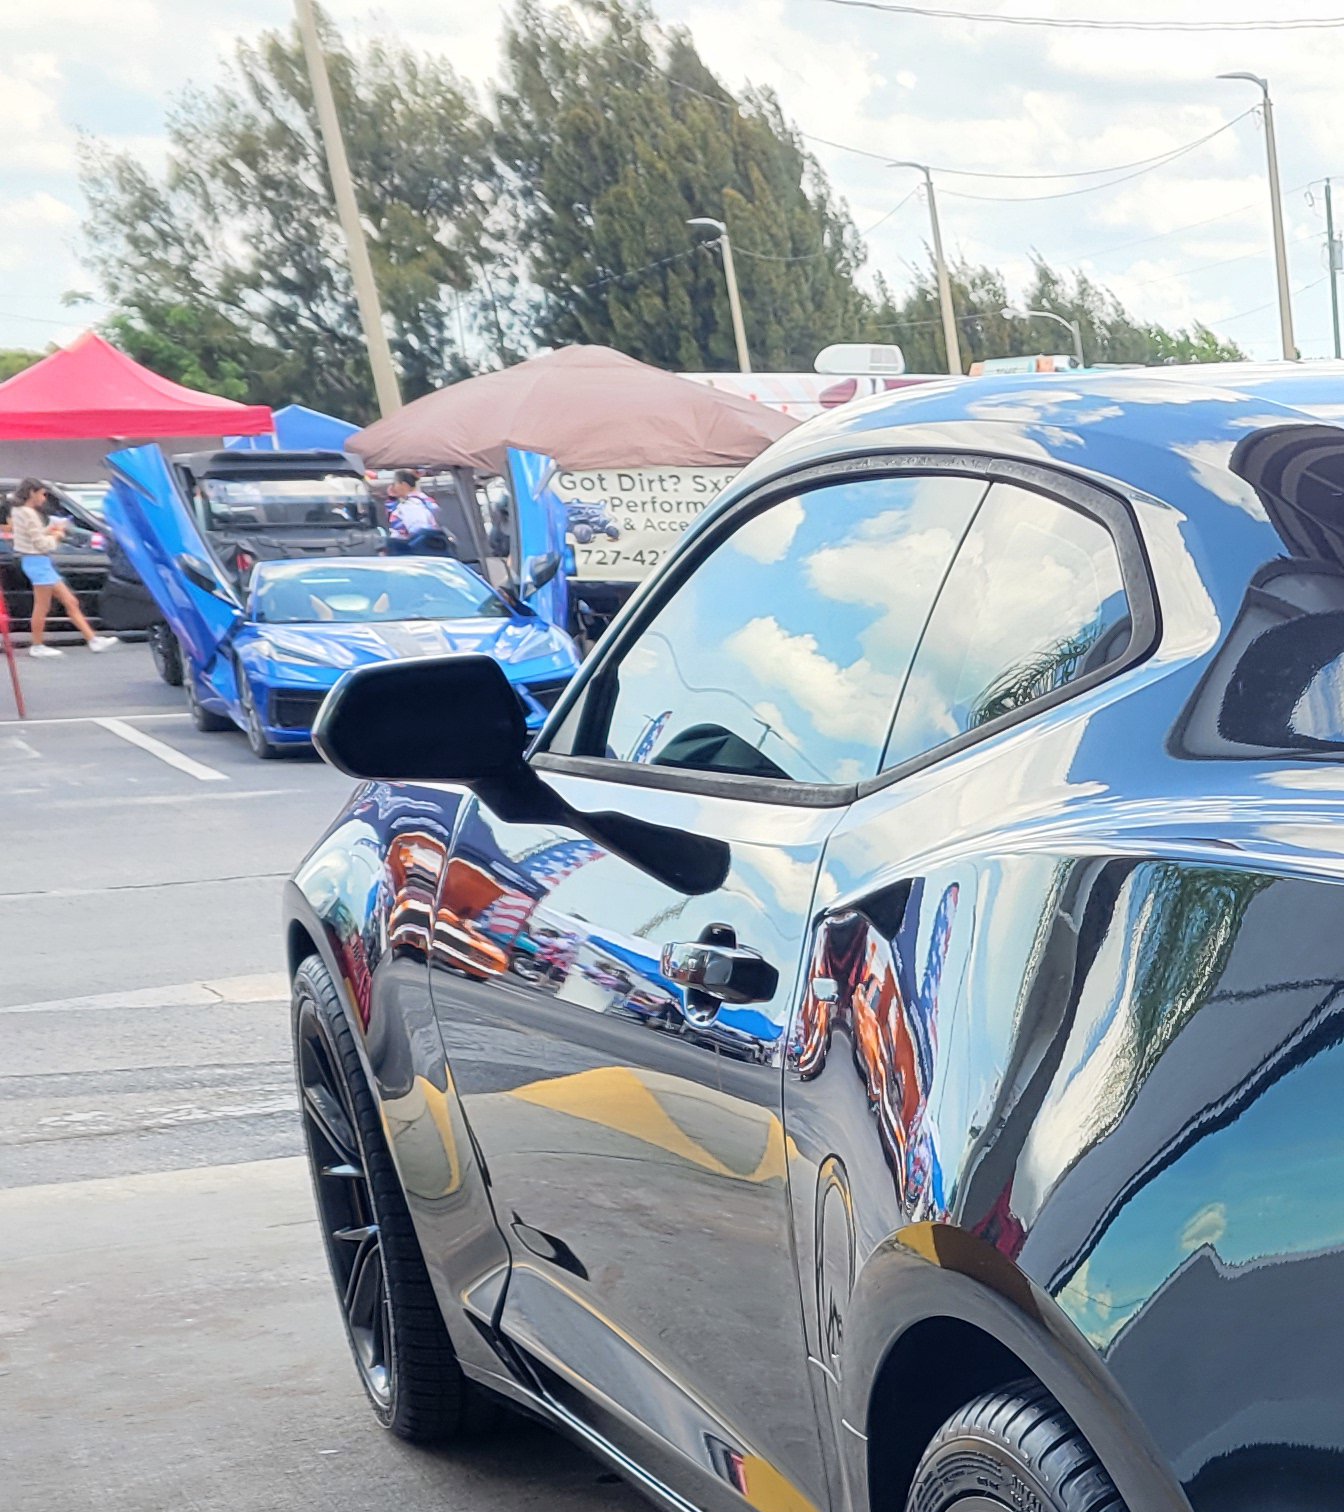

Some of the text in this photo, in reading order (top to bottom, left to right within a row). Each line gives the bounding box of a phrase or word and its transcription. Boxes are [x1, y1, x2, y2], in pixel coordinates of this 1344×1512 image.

[558, 472, 608, 492] Got
[617, 473, 681, 493] Dirt?
[623, 517, 636, 531] &
[579, 548, 667, 566] 727-42
